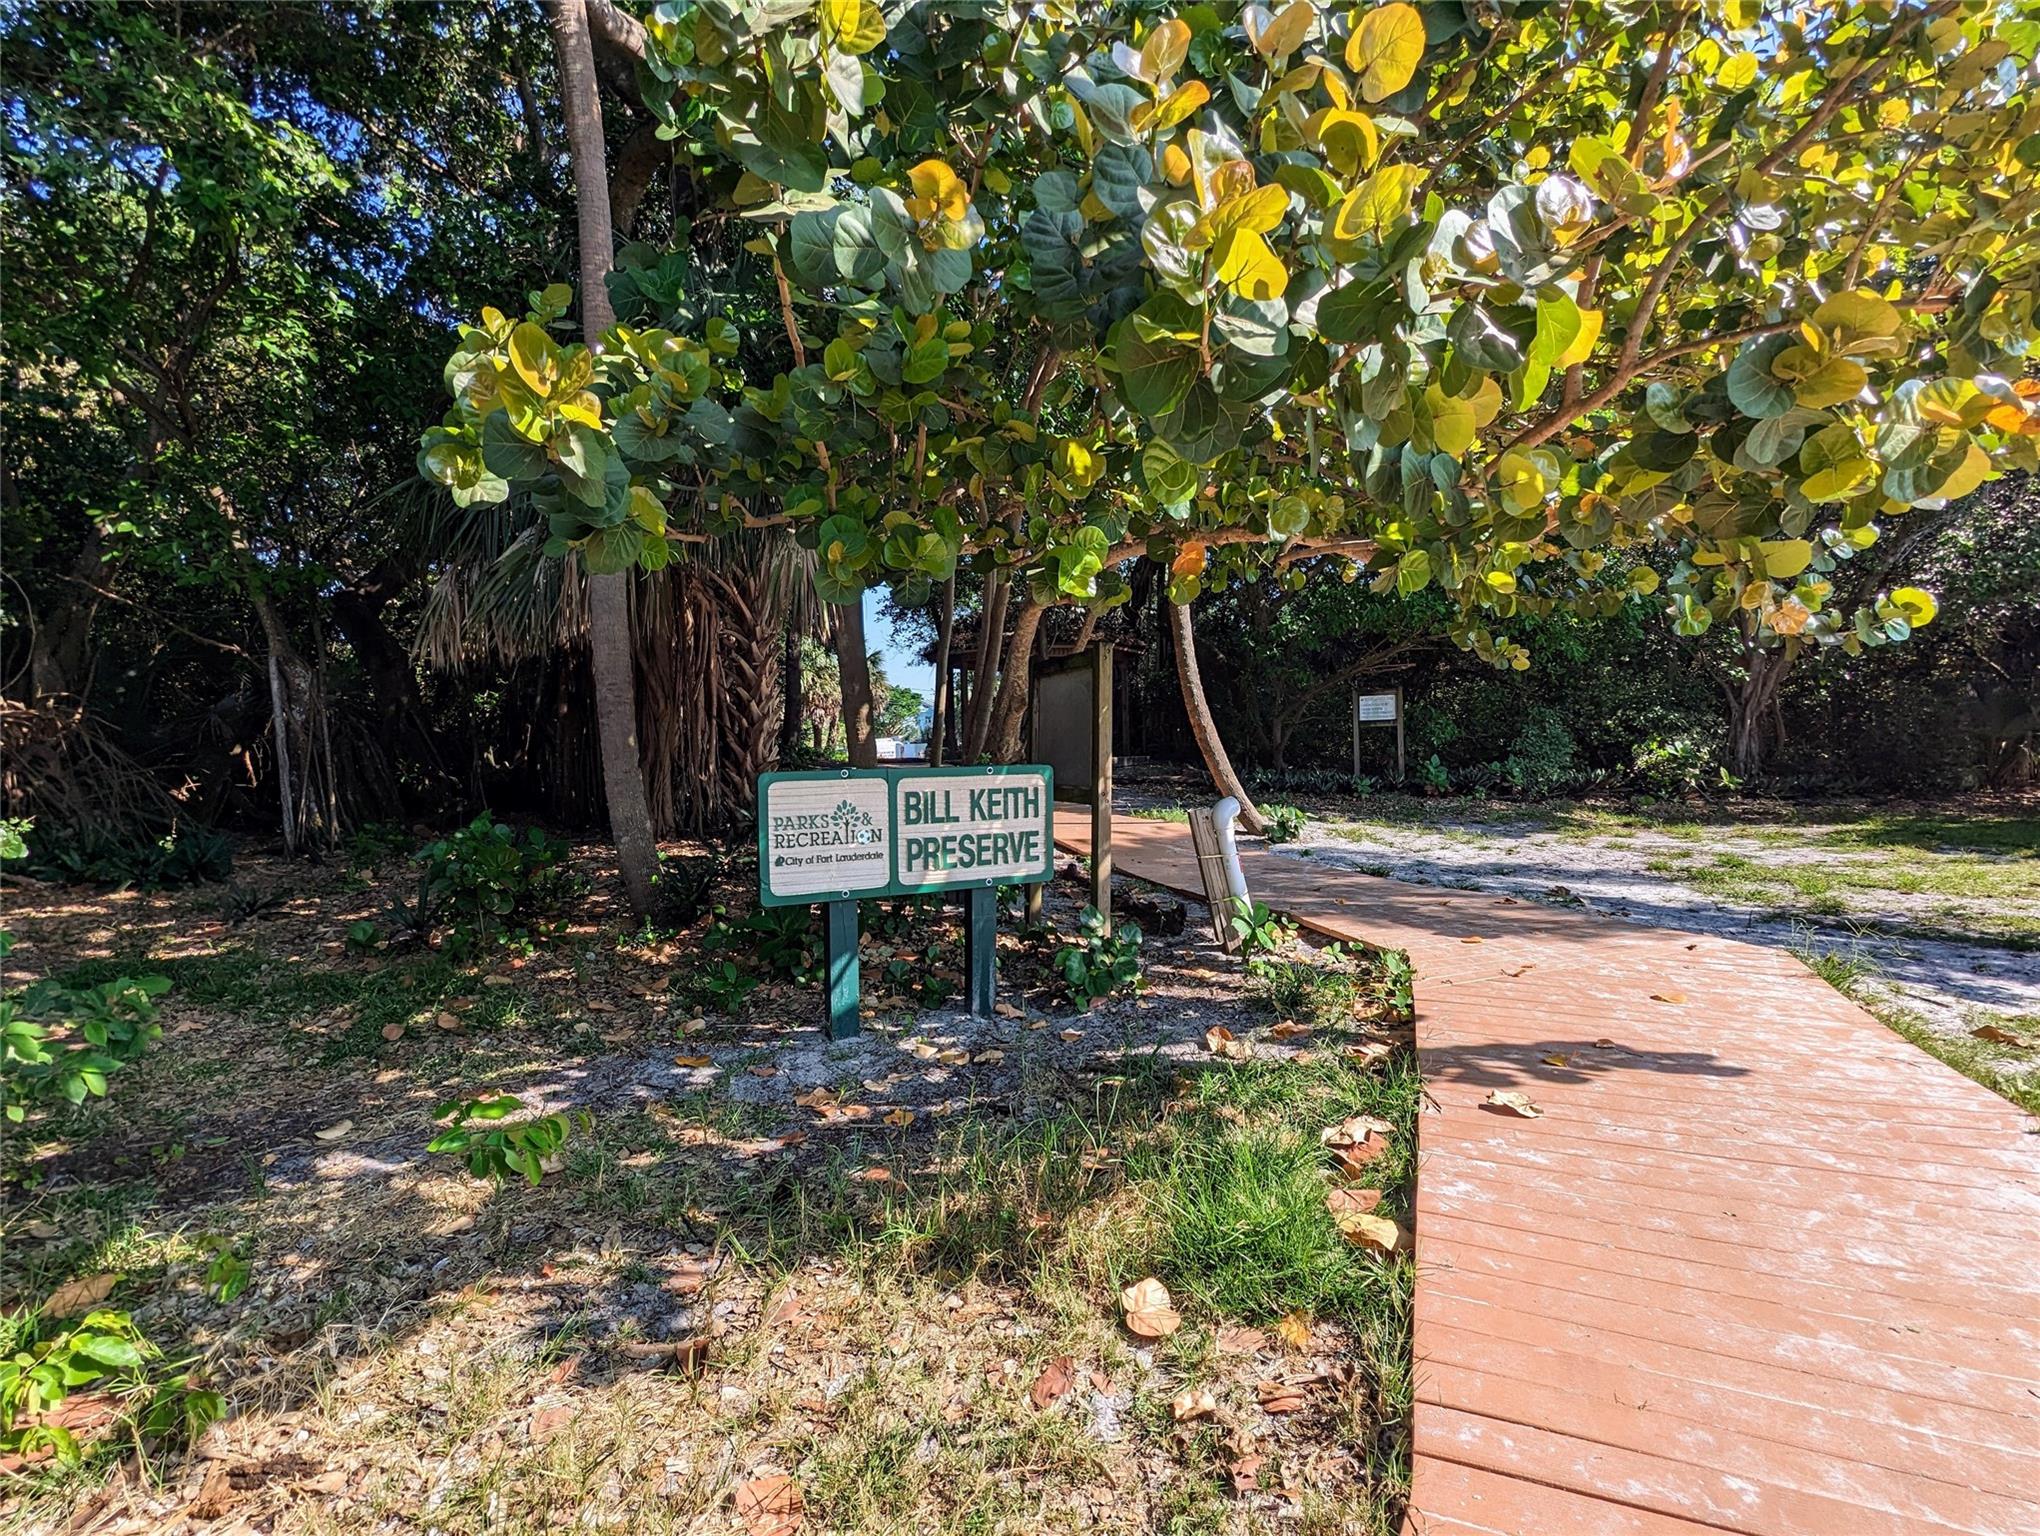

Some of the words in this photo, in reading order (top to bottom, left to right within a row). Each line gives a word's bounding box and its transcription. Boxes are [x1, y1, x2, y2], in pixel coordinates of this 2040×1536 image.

[905, 790, 960, 825] BILL
[970, 787, 1039, 822] KEITH
[773, 814, 829, 832] PARKS
[861, 812, 873, 827] &
[774, 828, 882, 849] RECREATION
[785, 857, 804, 867] City
[806, 855, 815, 865] of
[816, 854, 833, 864] Fort
[835, 852, 884, 863] Lauderdale
[907, 831, 1040, 872] PRESERVE
